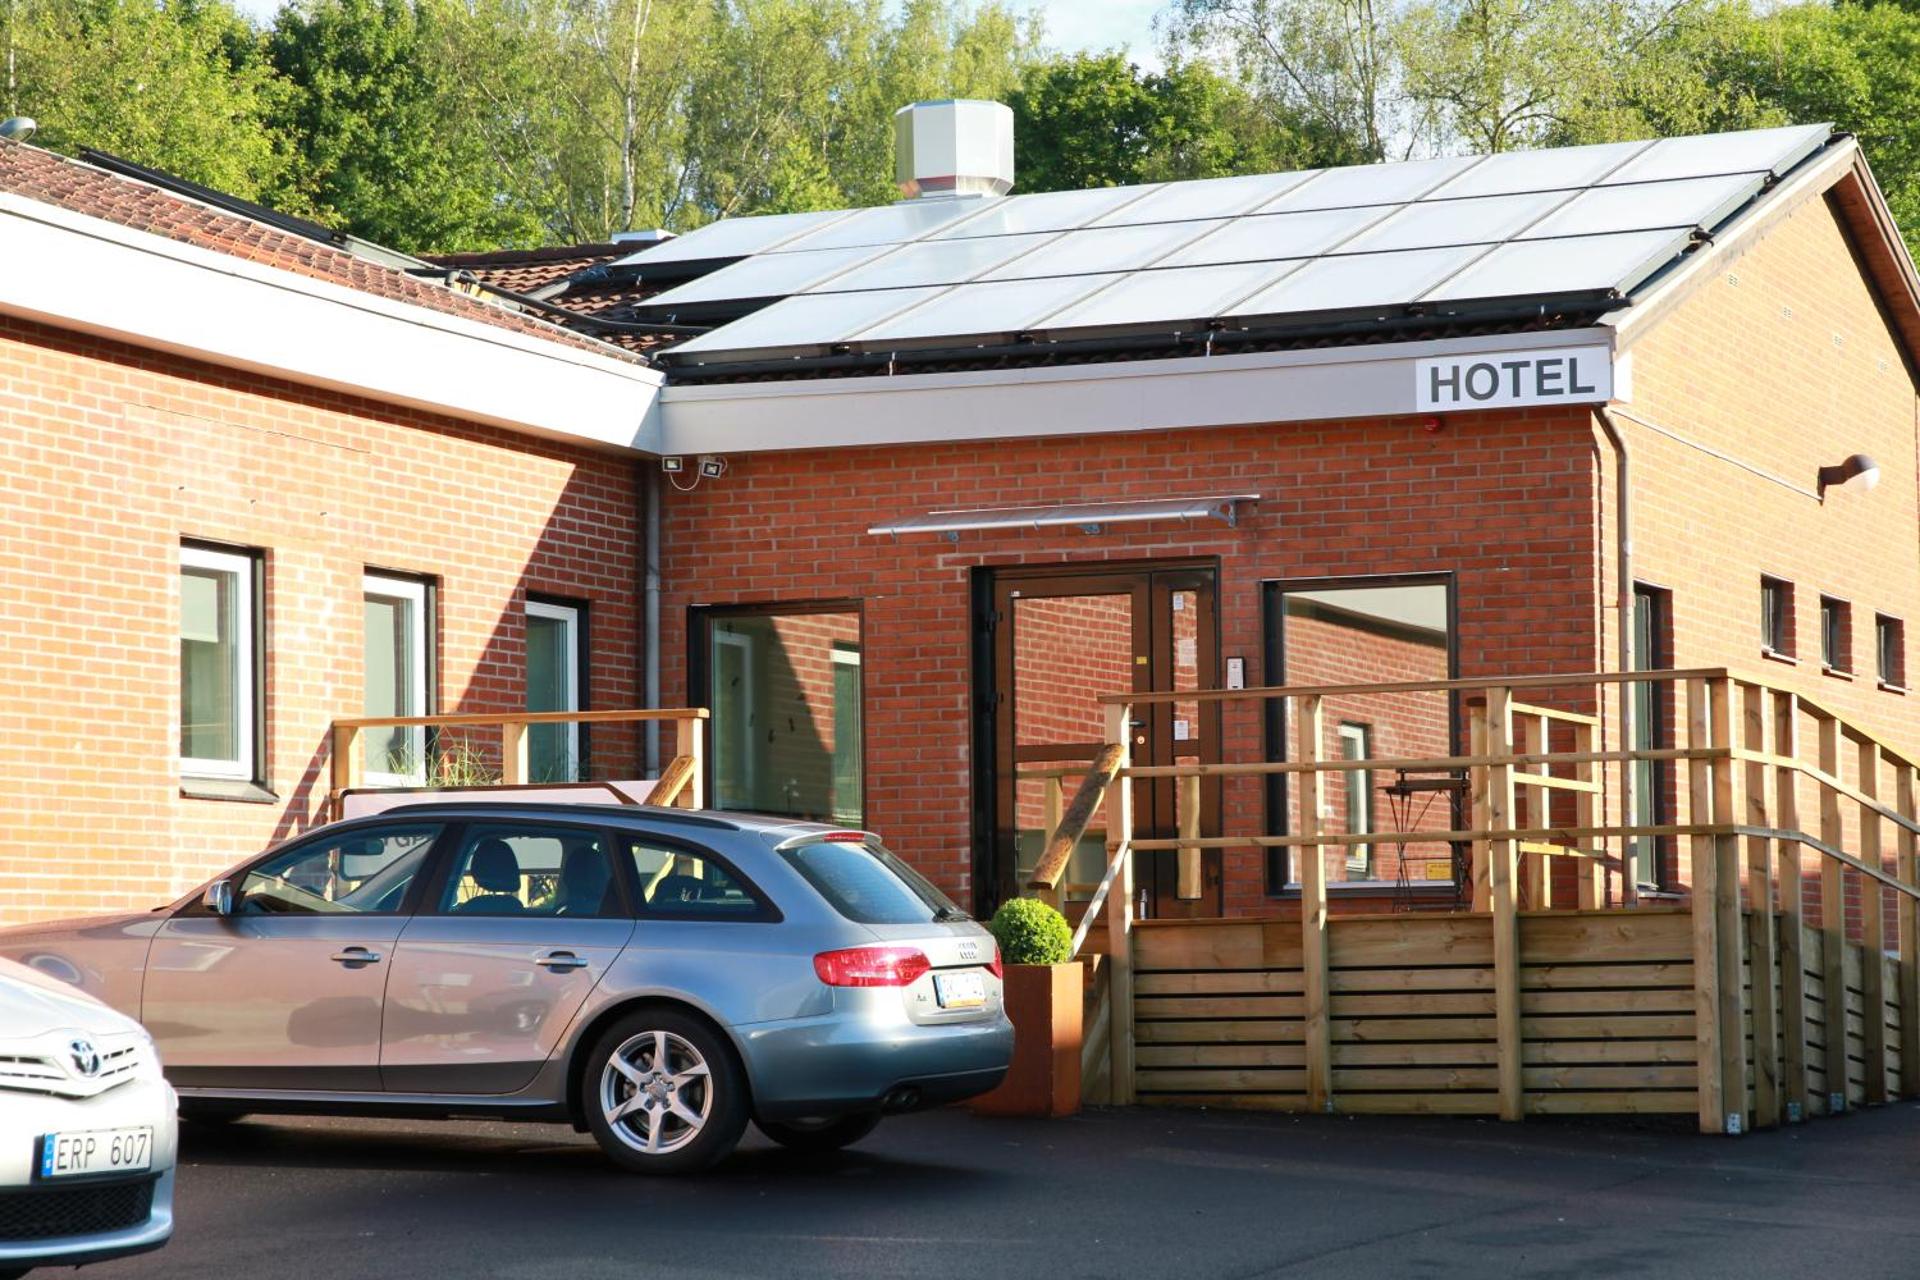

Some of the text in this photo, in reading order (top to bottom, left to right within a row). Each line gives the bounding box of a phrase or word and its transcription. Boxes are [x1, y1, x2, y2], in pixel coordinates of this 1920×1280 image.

[1431, 357, 1595, 402] HOTEL
[57, 1133, 147, 1170] ERP 607
